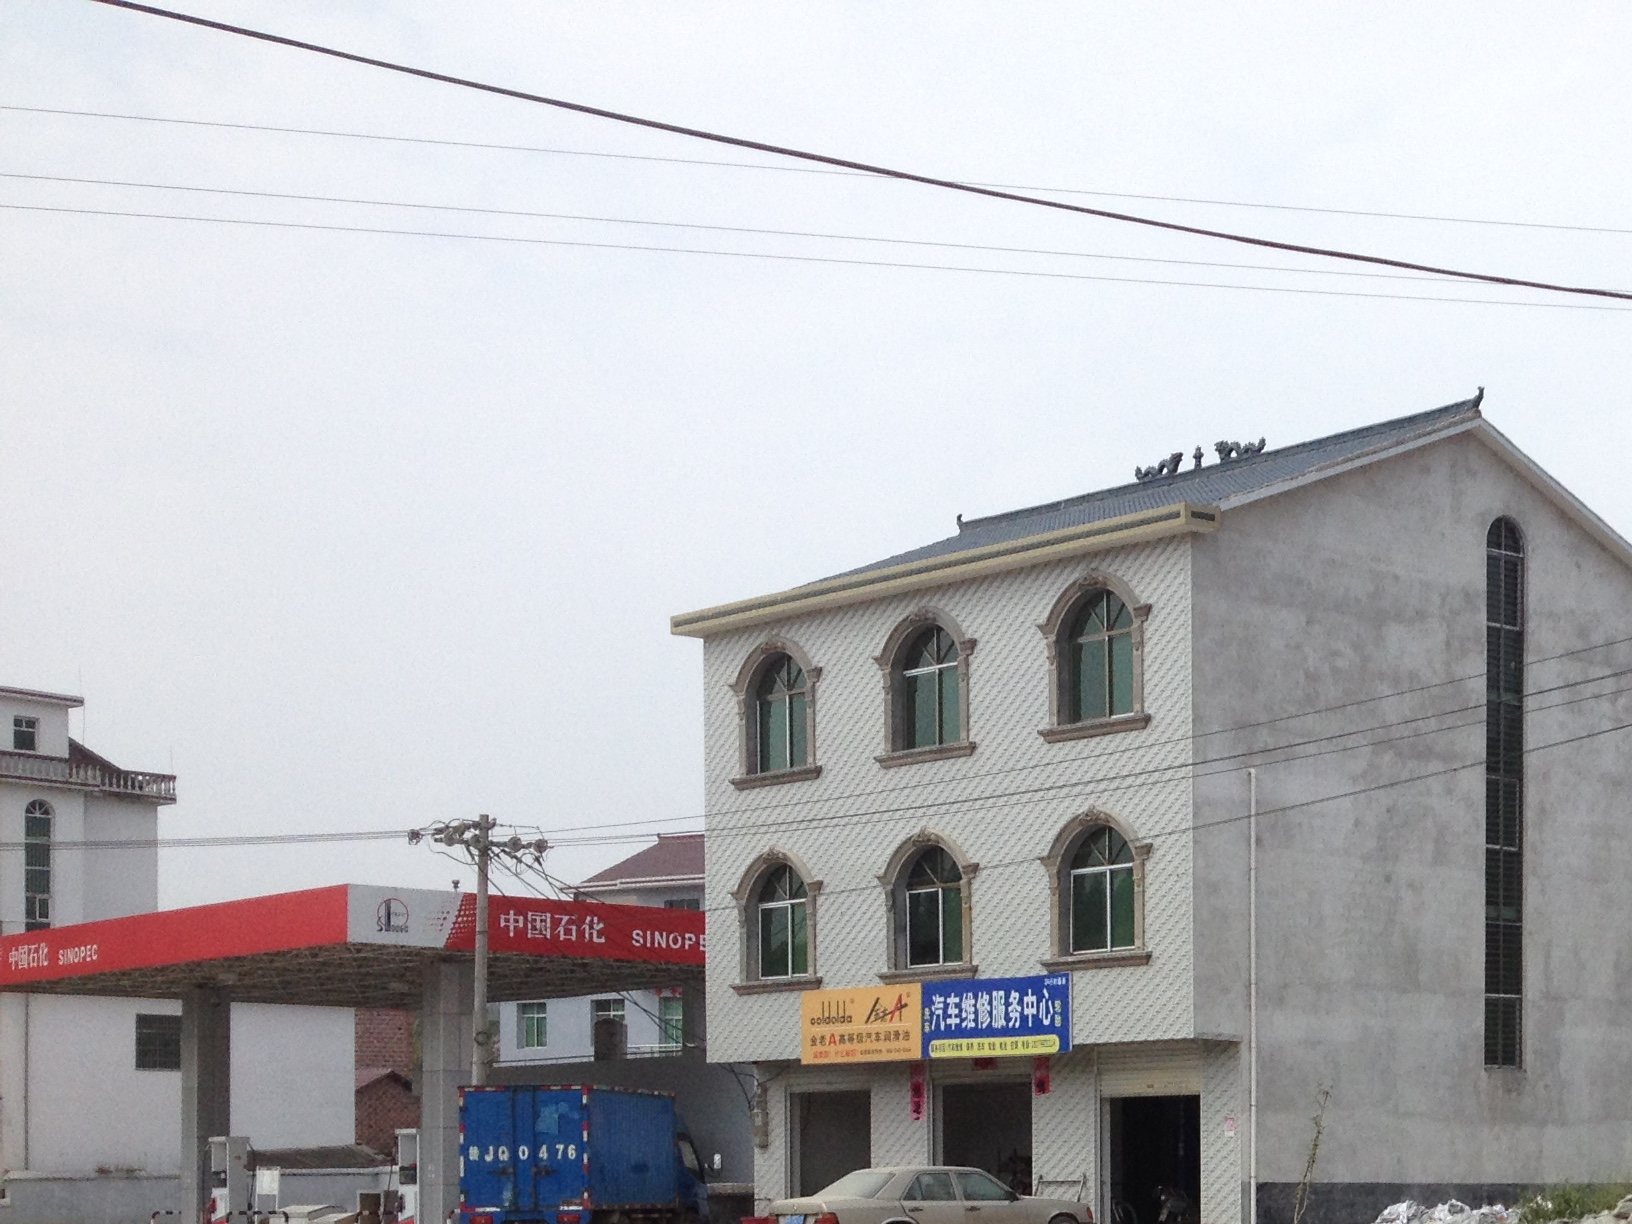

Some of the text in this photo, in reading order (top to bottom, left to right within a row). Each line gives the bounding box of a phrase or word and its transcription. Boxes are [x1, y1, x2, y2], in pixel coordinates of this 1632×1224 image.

[499, 909, 606, 943] 中国石化
[9, 943, 98, 970] 中国石化 SINOPEC
[931, 987, 1054, 1031] 汽车维修服务中心
